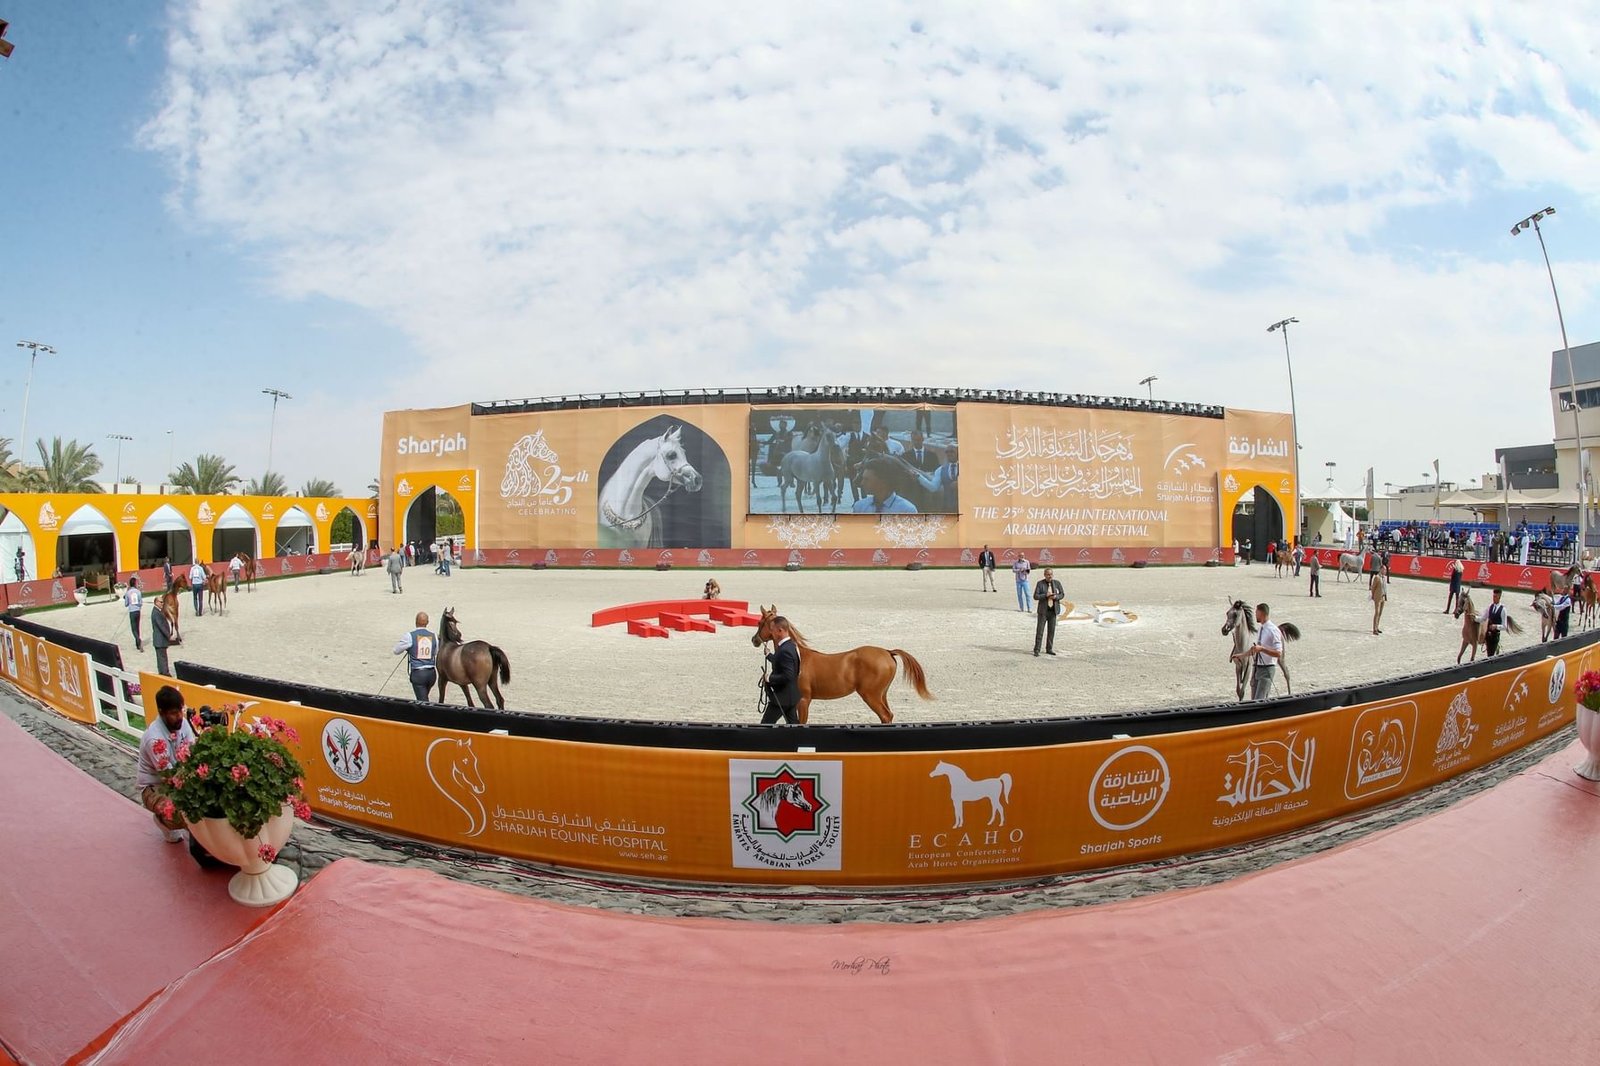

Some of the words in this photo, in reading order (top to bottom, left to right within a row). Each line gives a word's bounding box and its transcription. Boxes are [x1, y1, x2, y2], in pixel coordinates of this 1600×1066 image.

[397, 432, 467, 456] Sharjah
[1229, 436, 1288, 459] الشارقة
[1156, 480, 1188, 492] الشارقة
[1156, 493, 1184, 503] Sharjah
[1184, 494, 1215, 503] Airport
[518, 508, 577, 516] CELEBRATING
[974, 506, 998, 519] THE
[1027, 508, 1080, 521] SHARJAH
[1082, 509, 1169, 522] INTERNATIONAL
[1003, 523, 1055, 536] ARABIAN
[1058, 524, 1099, 536] HORSE
[1101, 524, 1149, 537] FESTIVAL
[421, 647, 430, 656] 10
[1103, 768, 1160, 790] الشارقة
[318, 785, 342, 797] الرياضي
[343, 788, 367, 801] الشارقة
[1100, 787, 1158, 809] الرياضية
[319, 794, 344, 807] Sharjah
[343, 799, 366, 813] Sports
[366, 806, 394, 820] Council
[491, 804, 536, 821] للخيول
[537, 810, 592, 829] الشارقة
[594, 818, 666, 836] مستشفى
[493, 820, 547, 838] SHARJAH
[550, 828, 599, 845] EQUINE
[602, 833, 668, 852] HOSPITAL
[732, 813, 751, 852] EMIRATES
[752, 852, 791, 869] ARABIAN
[797, 851, 826, 867] HORSE
[825, 815, 840, 849] SOCIETY
[1080, 840, 1125, 855] Sharjah
[1127, 834, 1162, 849] Sports
[619, 850, 668, 862] www.seh.ae
[908, 852, 951, 860] European
[956, 848, 1008, 858] Conference
[1012, 846, 1022, 854] of
[908, 861, 929, 869] Arab
[933, 859, 958, 868] Horse
[961, 856, 1020, 867] Organizations
